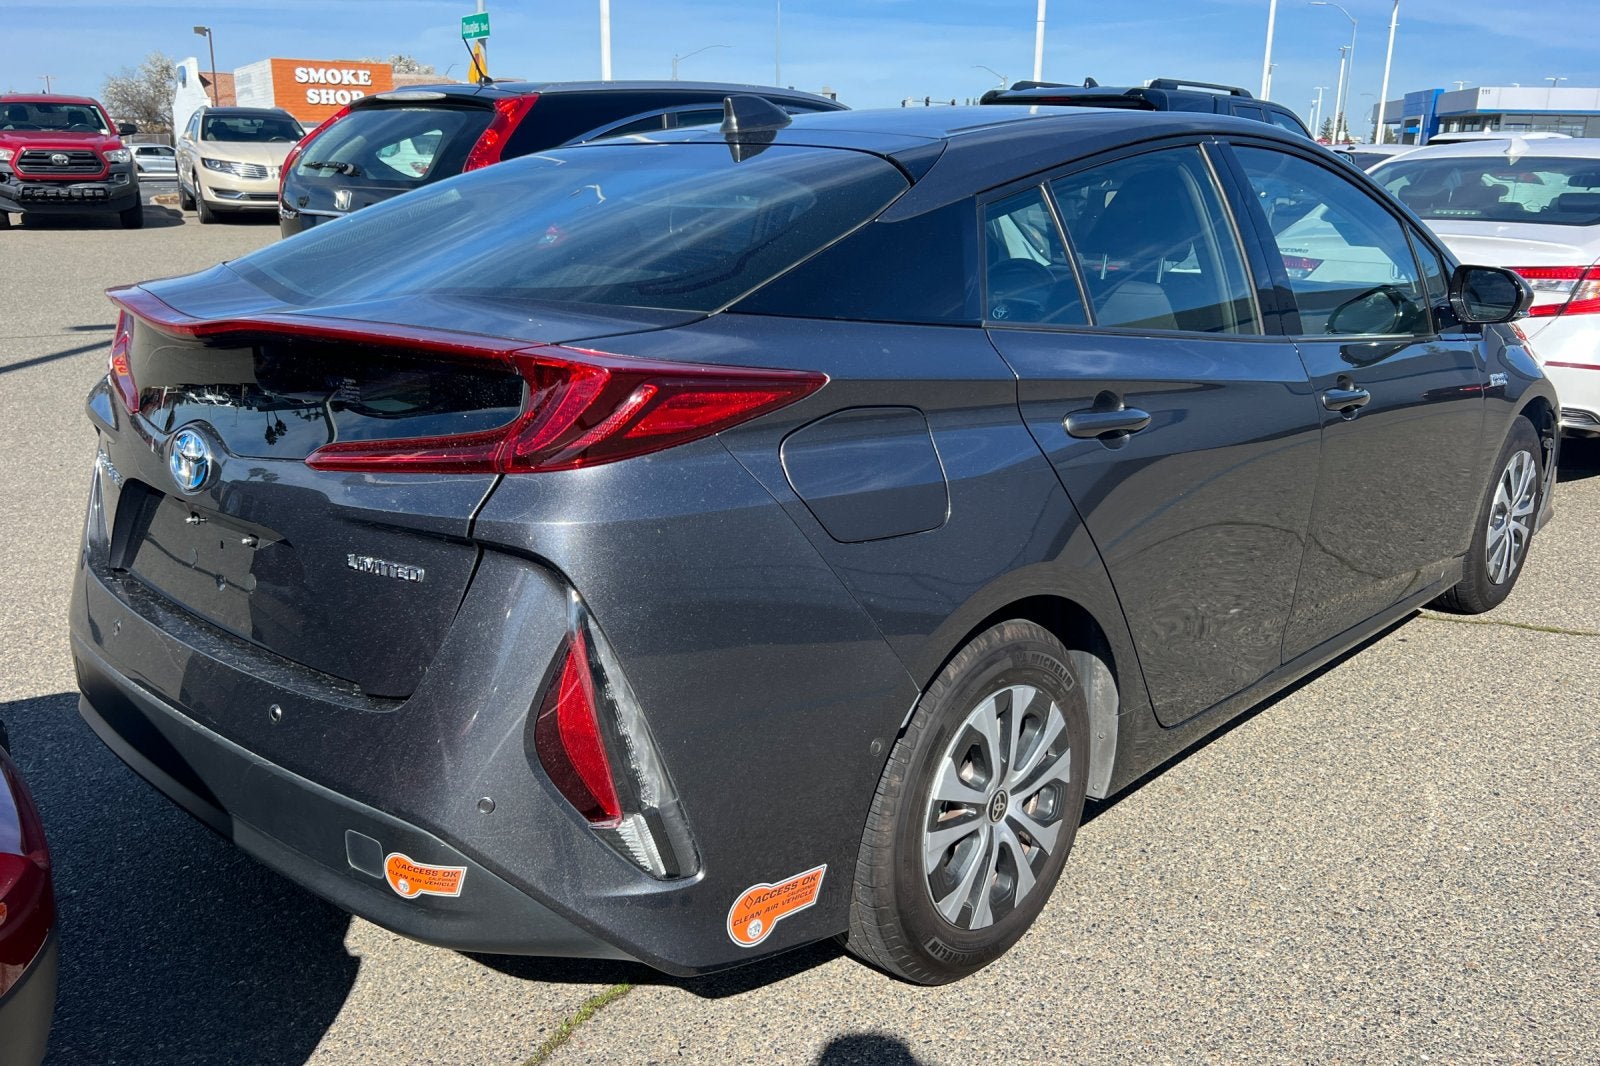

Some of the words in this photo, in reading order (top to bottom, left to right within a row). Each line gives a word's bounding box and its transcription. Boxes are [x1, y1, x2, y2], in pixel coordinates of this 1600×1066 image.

[294, 67, 372, 86] SMOKE
[306, 88, 365, 106] SHOP
[347, 553, 425, 583] LIMITED
[1030, 653, 1074, 688] MICHELIN
[388, 869, 409, 880] CLEAN
[401, 863, 438, 876] ACCESS
[753, 881, 799, 906] ACCESS
[802, 873, 819, 886] OK
[733, 910, 763, 926] CLEAN
[764, 903, 780, 914] AIR
[782, 888, 815, 906] VEHICLE
